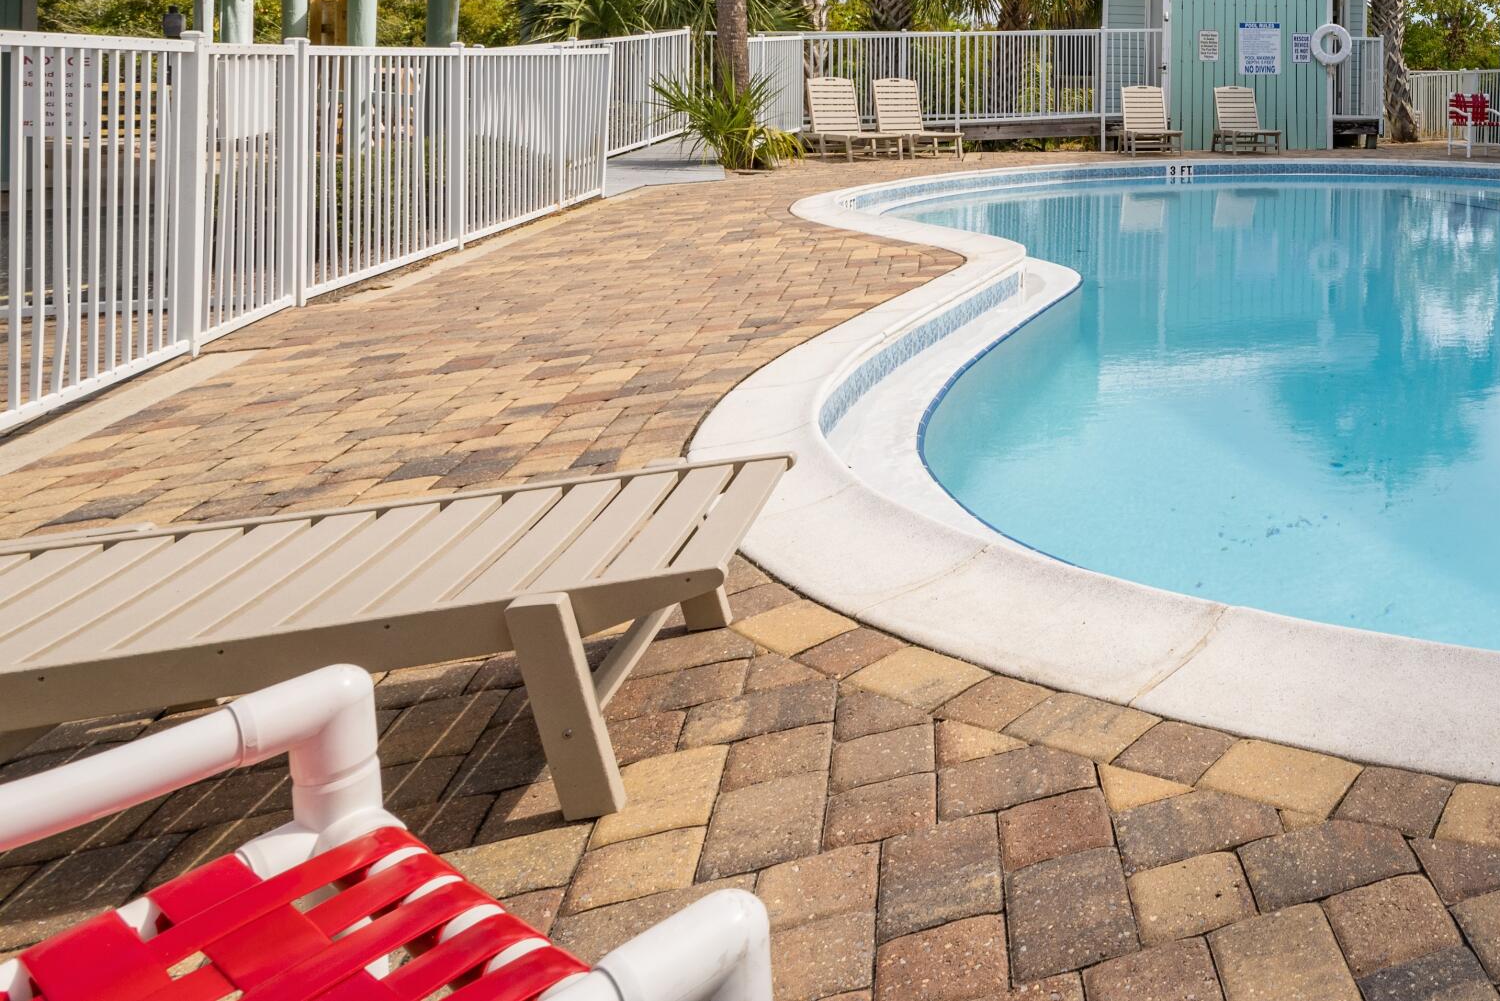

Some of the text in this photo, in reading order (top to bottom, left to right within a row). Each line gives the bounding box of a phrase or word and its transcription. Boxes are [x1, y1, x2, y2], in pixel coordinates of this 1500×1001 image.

[1245, 65, 1276, 73] NO DIVING
[1170, 165, 1176, 176] 3
